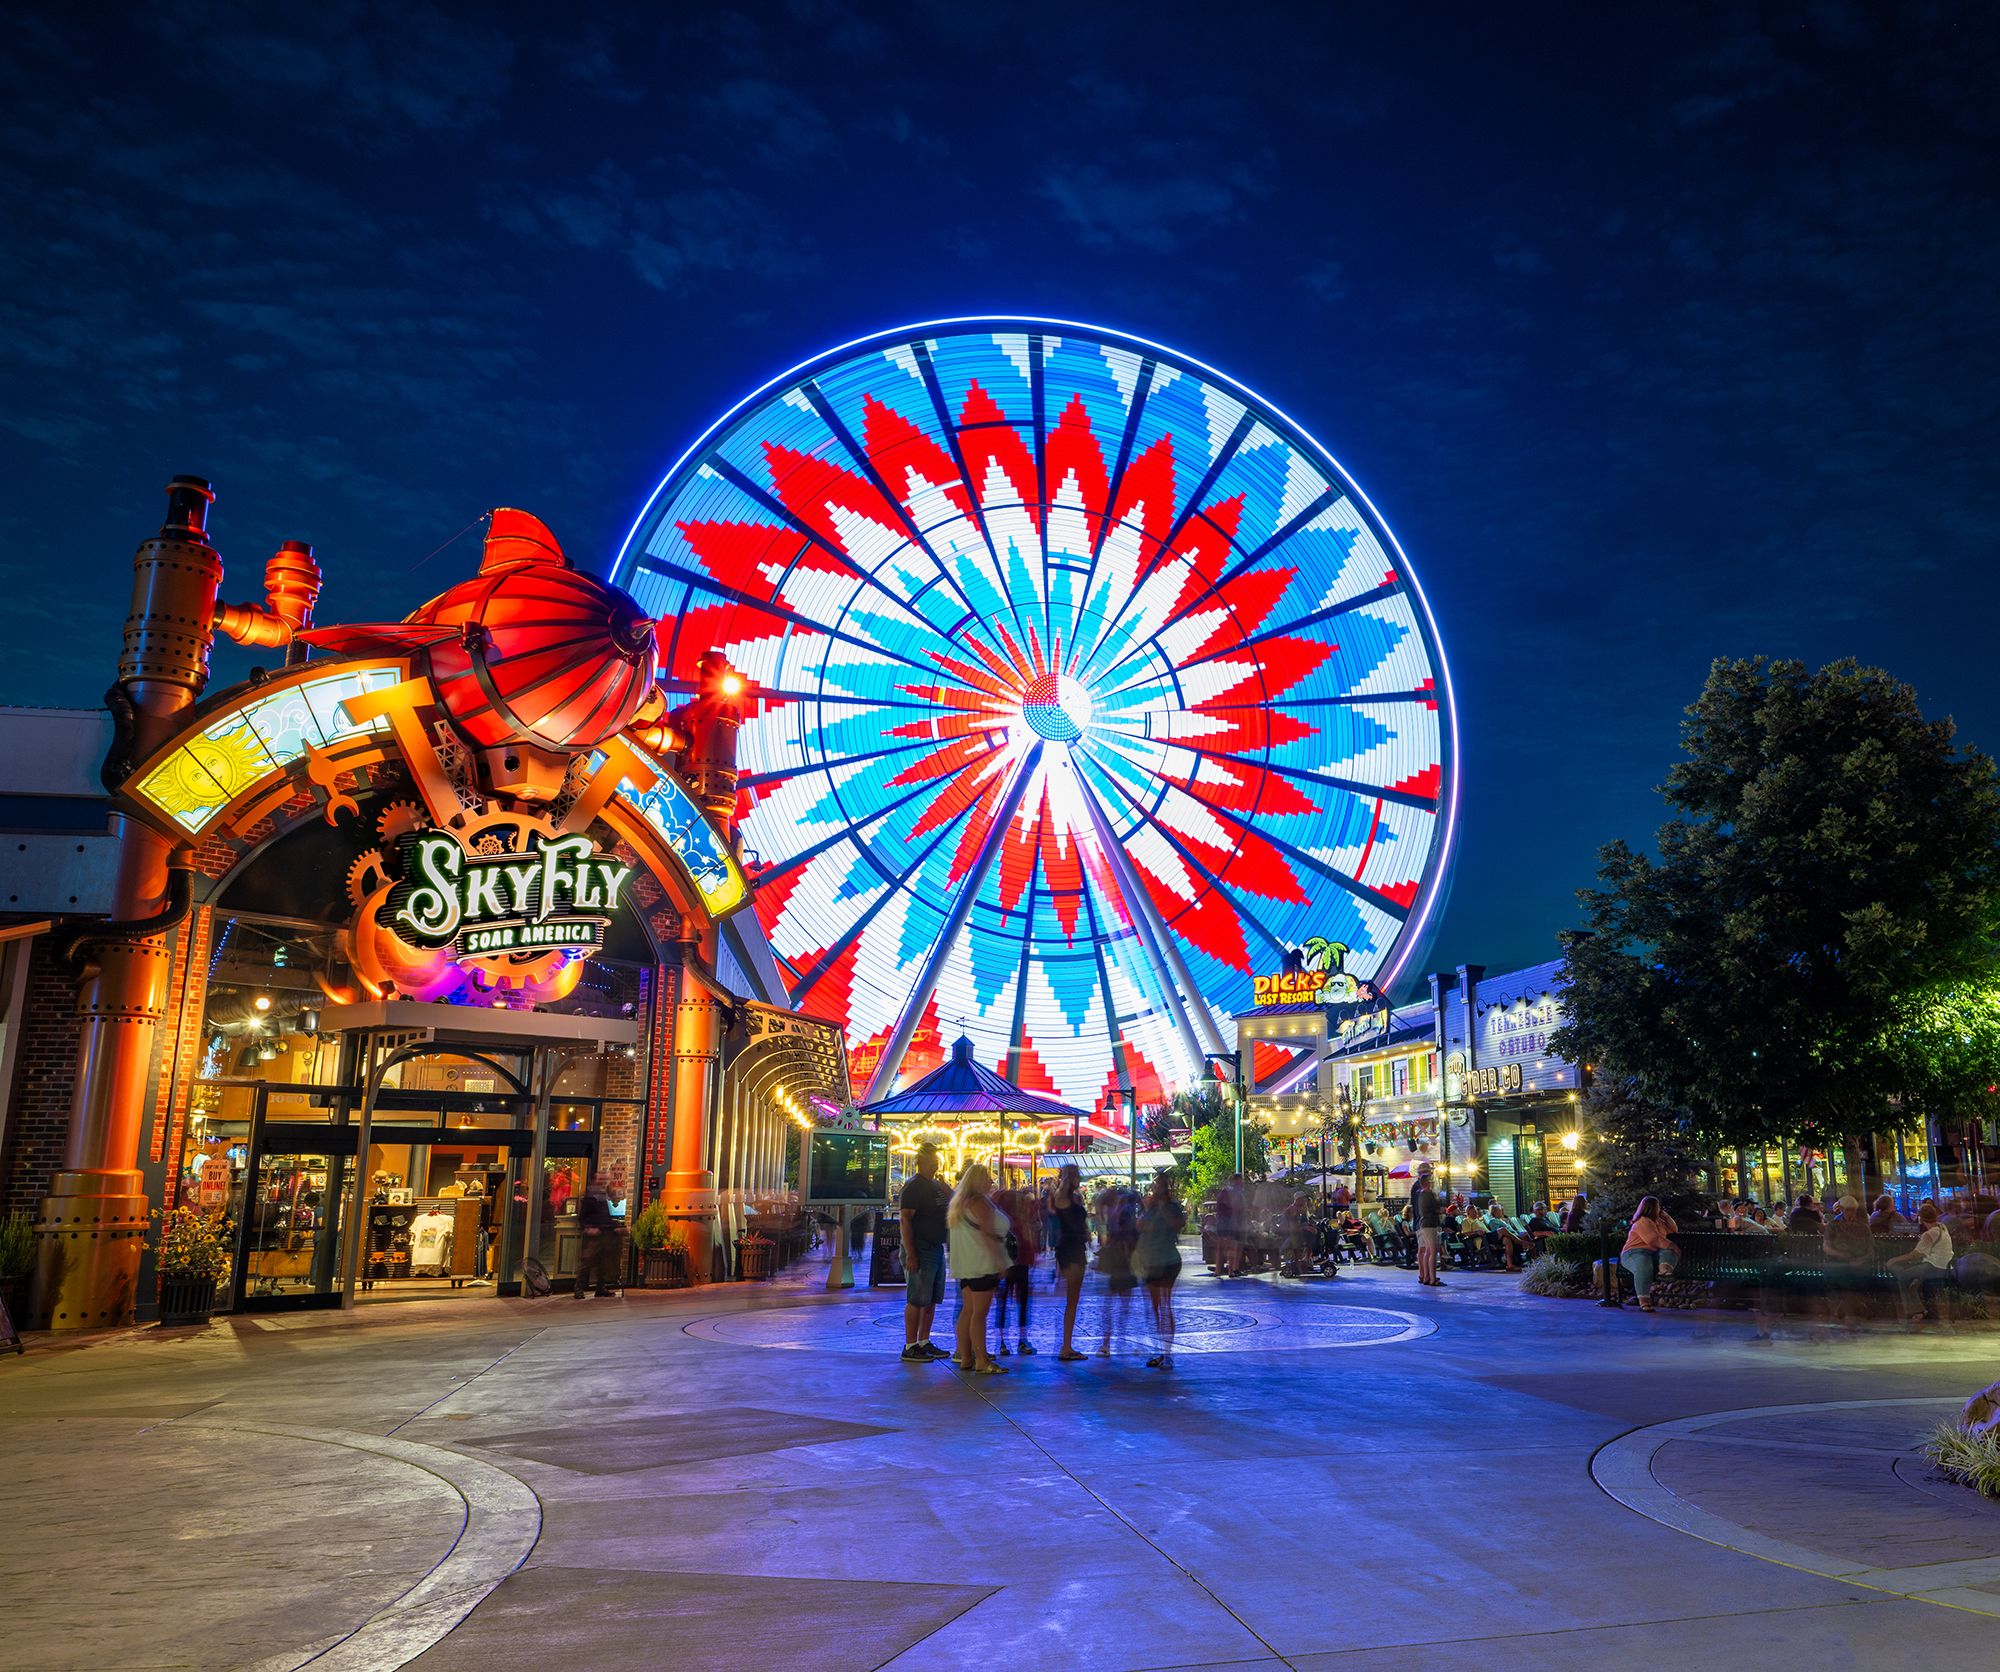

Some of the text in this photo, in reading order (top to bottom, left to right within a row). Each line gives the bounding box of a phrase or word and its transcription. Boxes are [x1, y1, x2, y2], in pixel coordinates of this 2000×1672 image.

[469, 925, 591, 950] SOAR AMERICA
[1253, 970, 1326, 994] DICK'S
[1254, 991, 1314, 1006] LAST RESORT
[1460, 1064, 1520, 1096] CIDER CO
[208, 1171, 222, 1180] BUY
[202, 1181, 225, 1190] ONLINE!
[880, 1237, 893, 1246] TAKE
